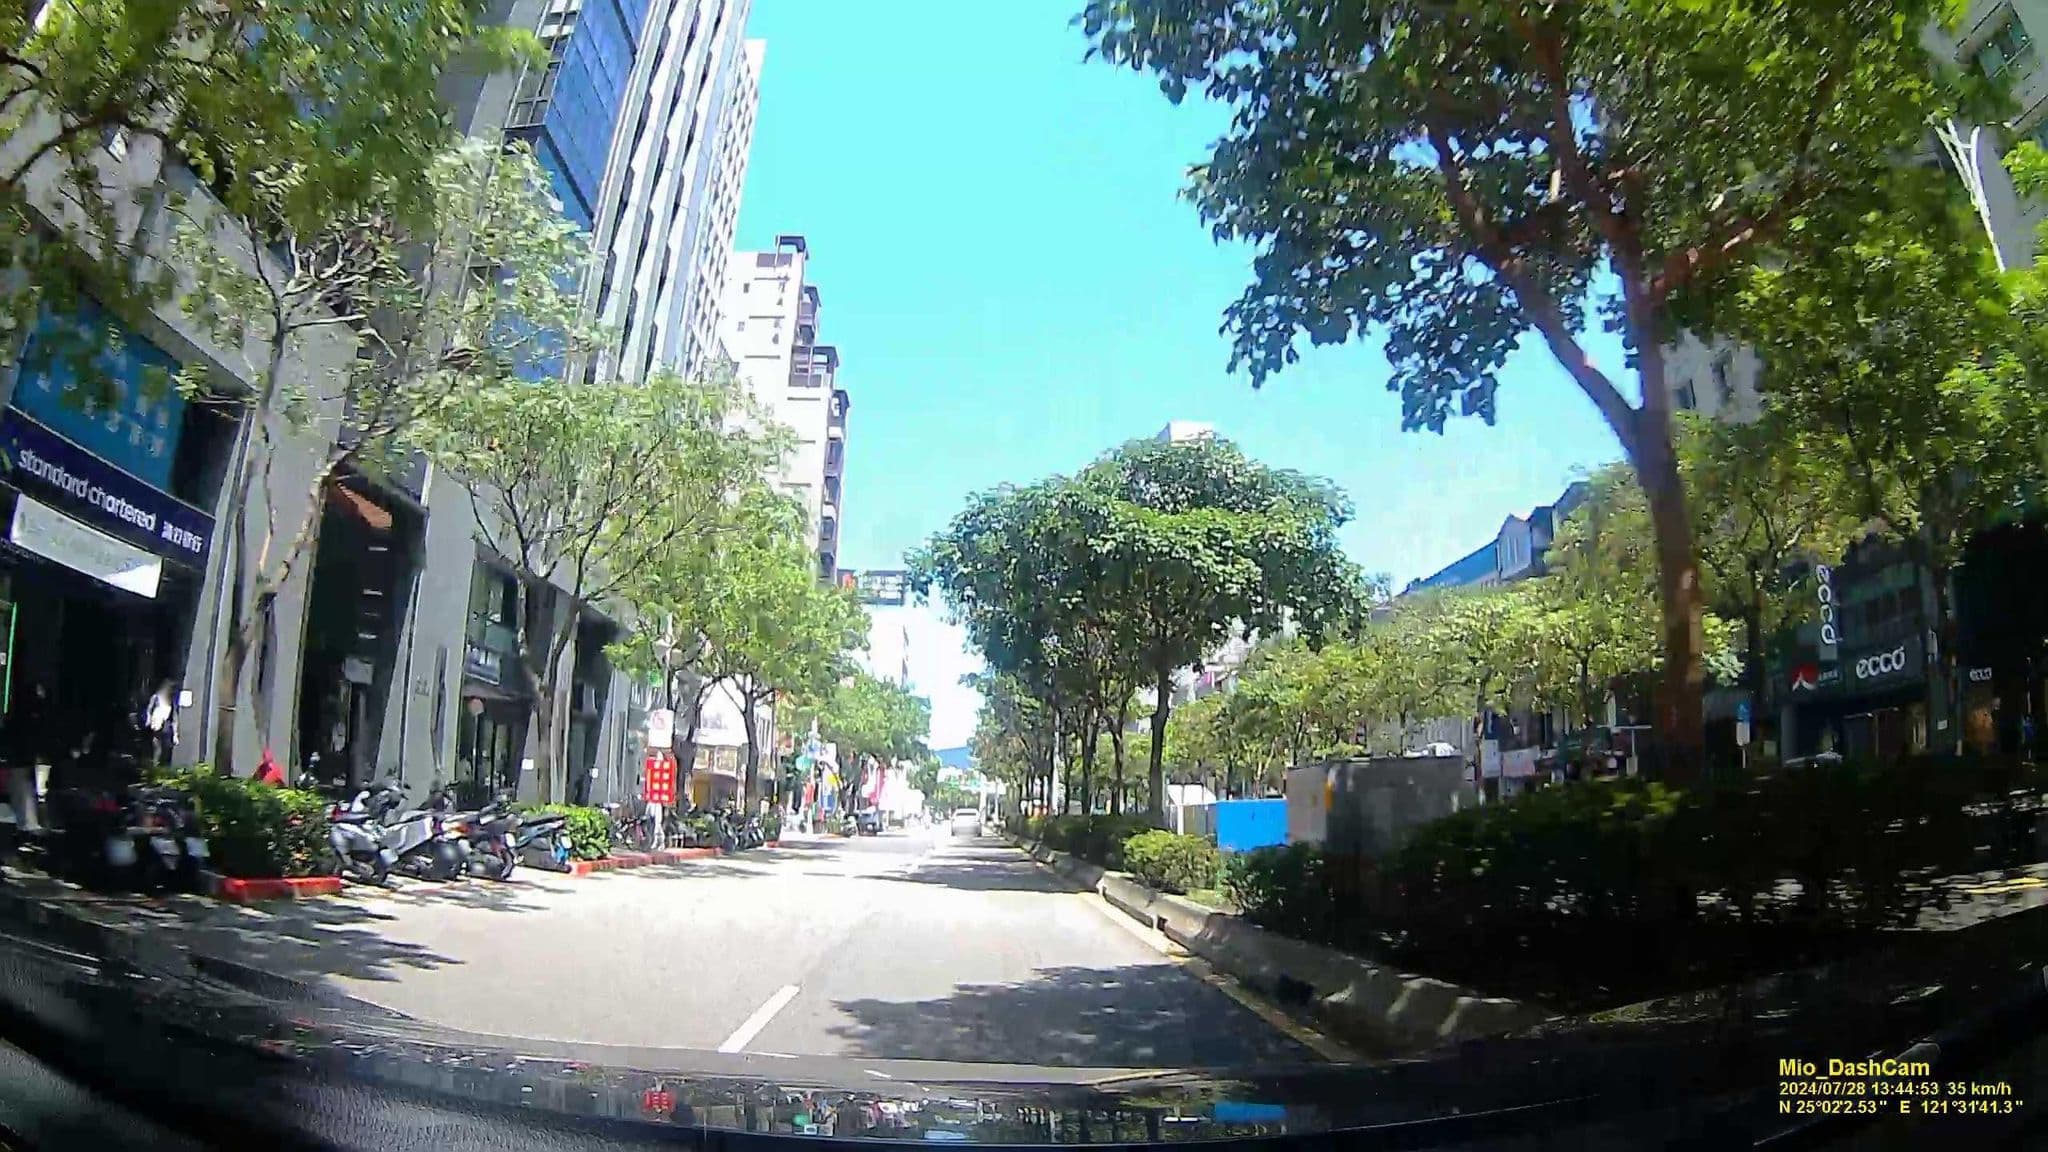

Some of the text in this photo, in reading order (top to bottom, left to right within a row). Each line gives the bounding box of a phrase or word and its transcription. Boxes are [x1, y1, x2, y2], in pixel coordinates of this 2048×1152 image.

[18, 448, 157, 532] standard chartered
[1815, 564, 1837, 645] ecco
[1855, 646, 1906, 679] ecco
